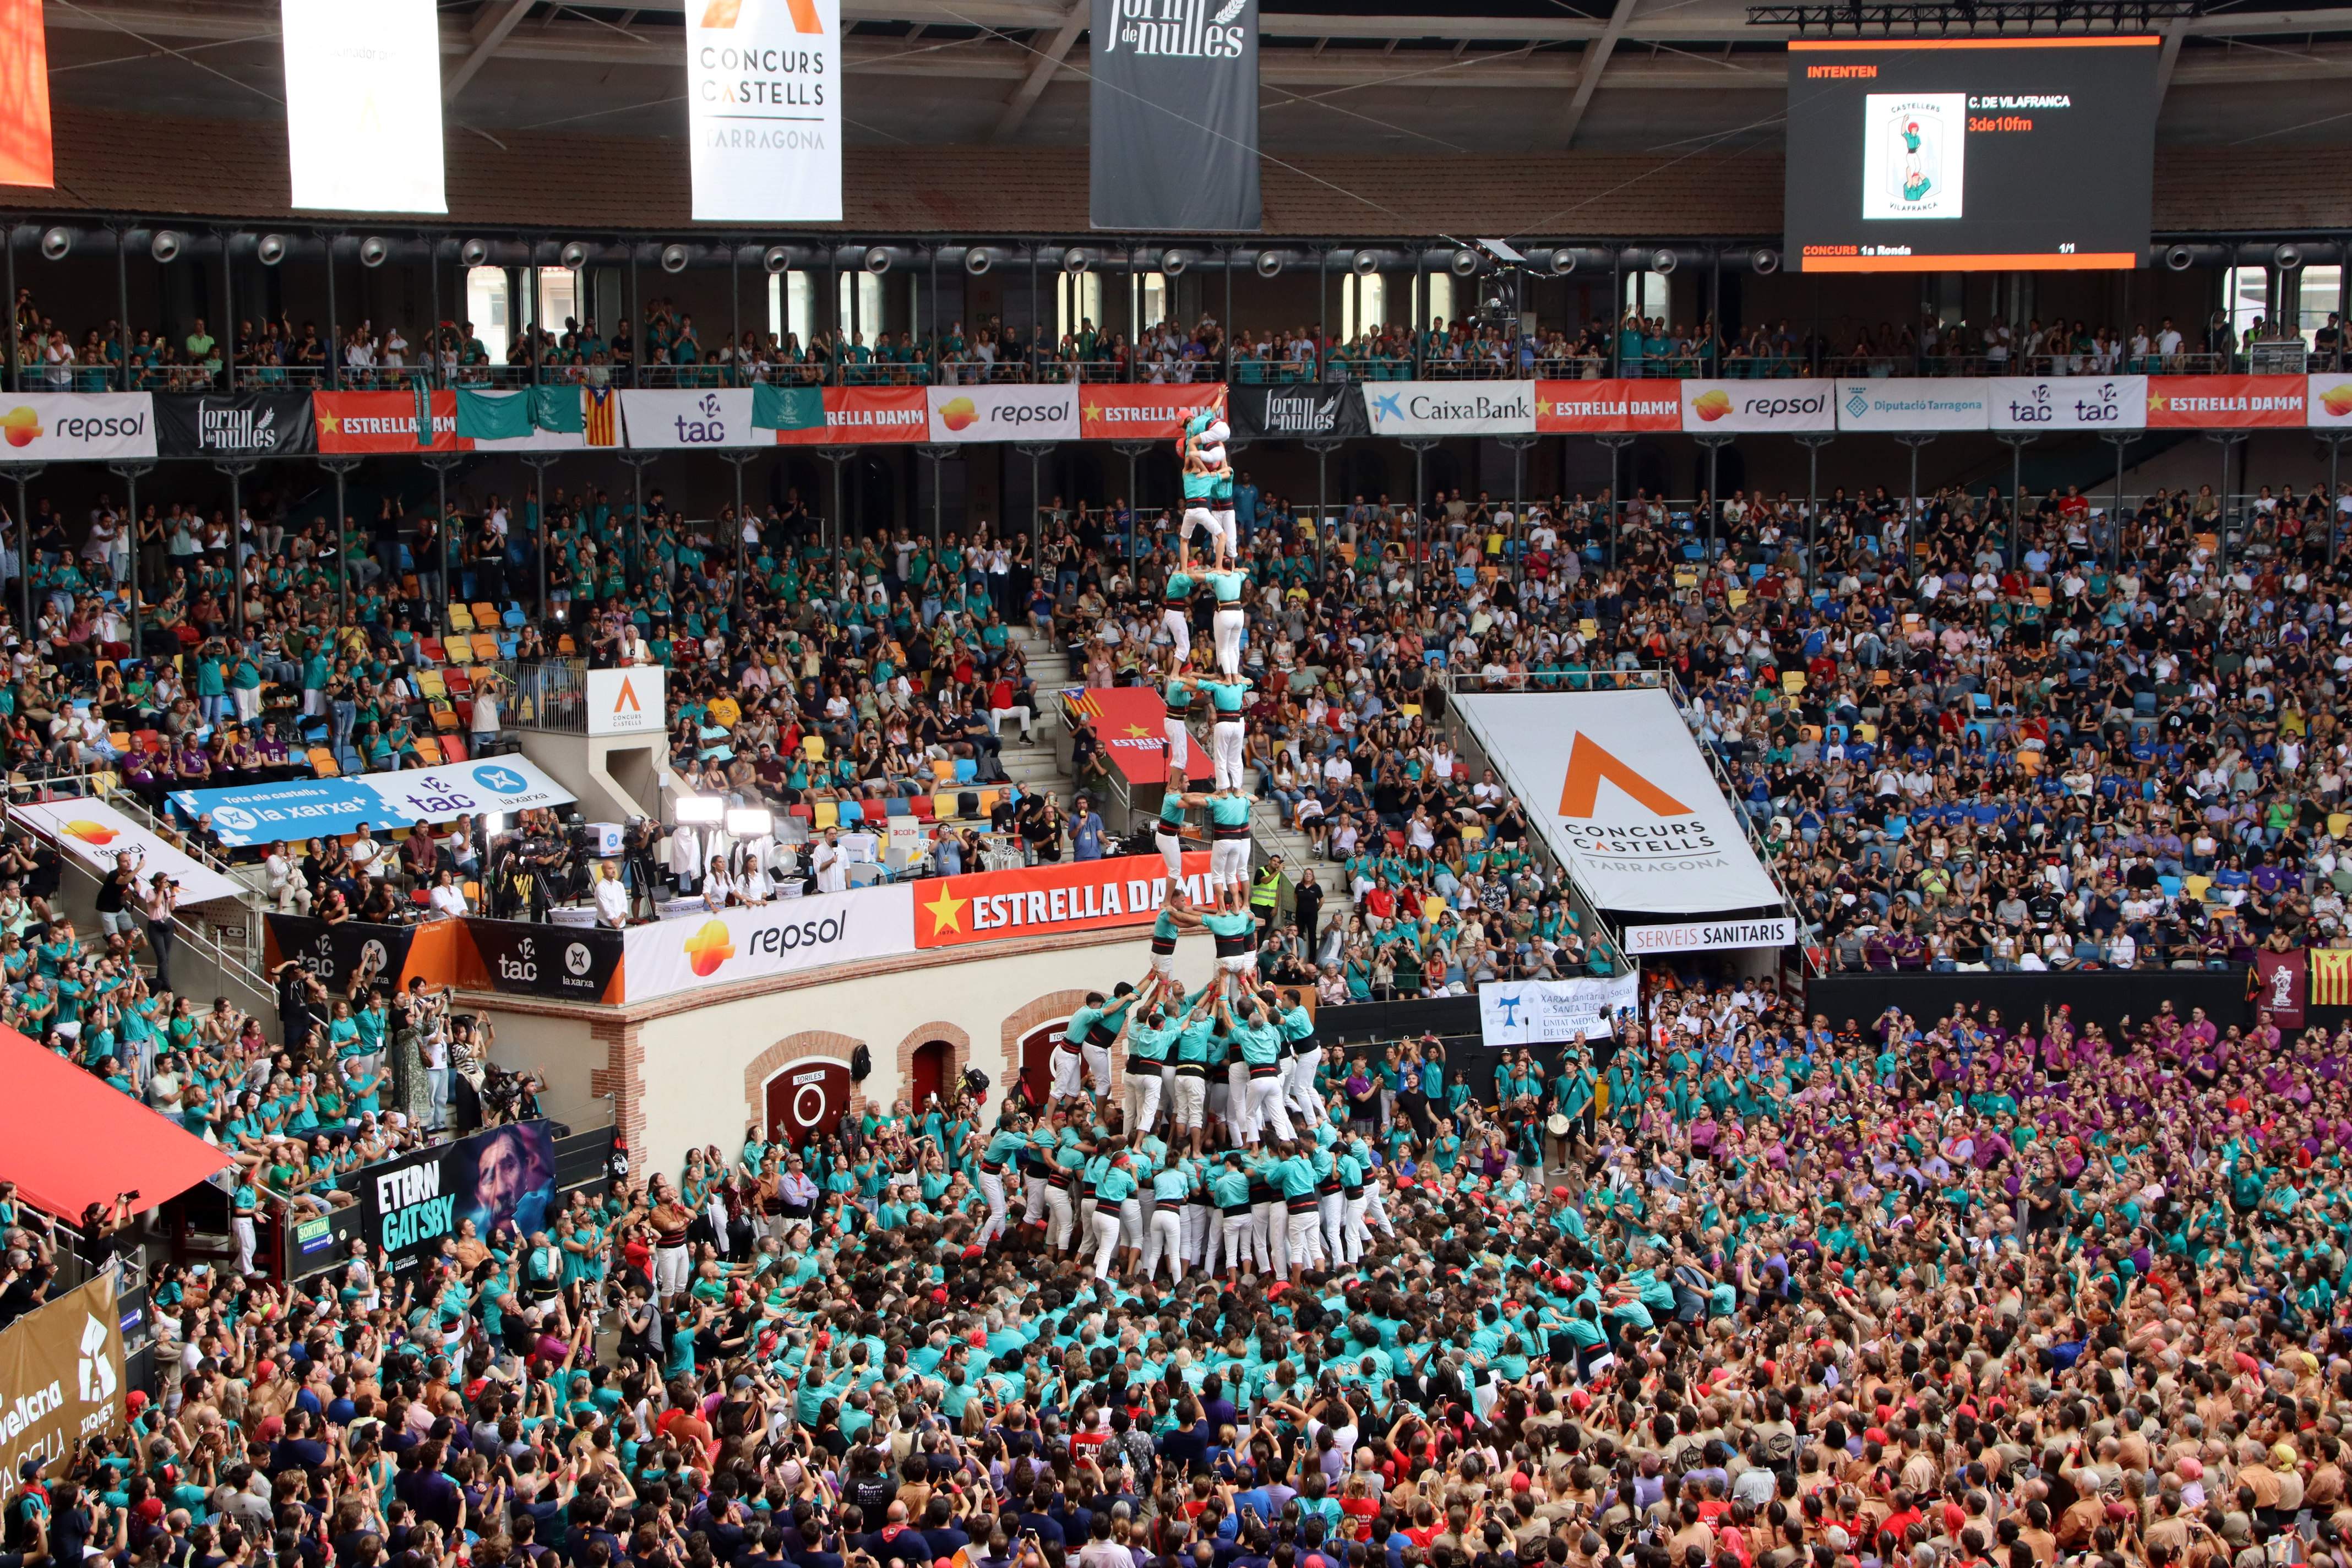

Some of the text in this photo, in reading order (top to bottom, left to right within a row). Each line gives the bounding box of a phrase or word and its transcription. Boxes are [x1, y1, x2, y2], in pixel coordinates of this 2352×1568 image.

[1122, 21, 1137, 42] de
[700, 47, 824, 74] CONCURS
[1807, 66, 1877, 78] INTENTEN
[701, 80, 824, 105] CASTELLS
[1891, 102, 1941, 113] CASTELLERS
[1968, 95, 2071, 109] C. DE VILAFRANCA
[1968, 117, 2033, 132] 3de10fm
[706, 129, 825, 150] TARRAGONA
[1890, 202, 1938, 211] VILAFRANCA
[1803, 245, 1911, 256] CONCURS 1a Ronda
[2059, 243, 2075, 254] 1/1
[1264, 389, 1303, 430] forn
[1411, 396, 1531, 420] CaixaBank
[1556, 401, 1678, 416] ESTRELLA DAMM
[1744, 394, 1825, 418] repsol
[1875, 400, 1982, 413] Diputació Tarragona
[2009, 399, 2119, 422] tac tac
[2170, 396, 2302, 411] ESTRELLA DAMM
[824, 410, 924, 426] RELLA DAMM
[992, 401, 1069, 426] repsol
[1106, 406, 1176, 421] ESTRELLA
[57, 412, 144, 442] repsol
[198, 399, 241, 448] forn
[344, 417, 420, 434] ESTRELLA
[674, 415, 725, 443] tac
[205, 431, 215, 444] de
[1111, 737, 1171, 747] ESTRELL
[222, 796, 251, 804] Tots
[252, 793, 270, 802] els
[270, 788, 314, 799] castells
[406, 794, 476, 813] tac
[499, 792, 549, 806] la xarxa
[251, 804, 287, 821] la
[1565, 821, 1706, 839] CONCURS
[94, 843, 147, 859] repsol
[1573, 836, 1715, 852] CASTELLS
[1585, 858, 1729, 873] TARRAGONA
[972, 882, 1123, 931] ESTRELLA
[749, 910, 846, 958] repsol
[1636, 924, 1784, 948] SERVEIS SANITARIS
[297, 949, 334, 977] tac
[499, 954, 537, 981] tac
[371, 975, 389, 984] arxa
[563, 976, 594, 988] la xarxa
[1542, 994, 1569, 1003] XARXA
[1611, 986, 1632, 998] Social
[1553, 1004, 1580, 1014] SANTA
[1574, 1016, 1608, 1026] MEDICI
[797, 1072, 821, 1084] TORILES
[614, 1162, 624, 1170] gos
[377, 1160, 439, 1214] ETERN
[299, 1220, 328, 1239] SORTIDA
[382, 1193, 455, 1252] GATSBY
[395, 1254, 416, 1266] CASTELLERS
[395, 1259, 418, 1271] VILAFRANCA
